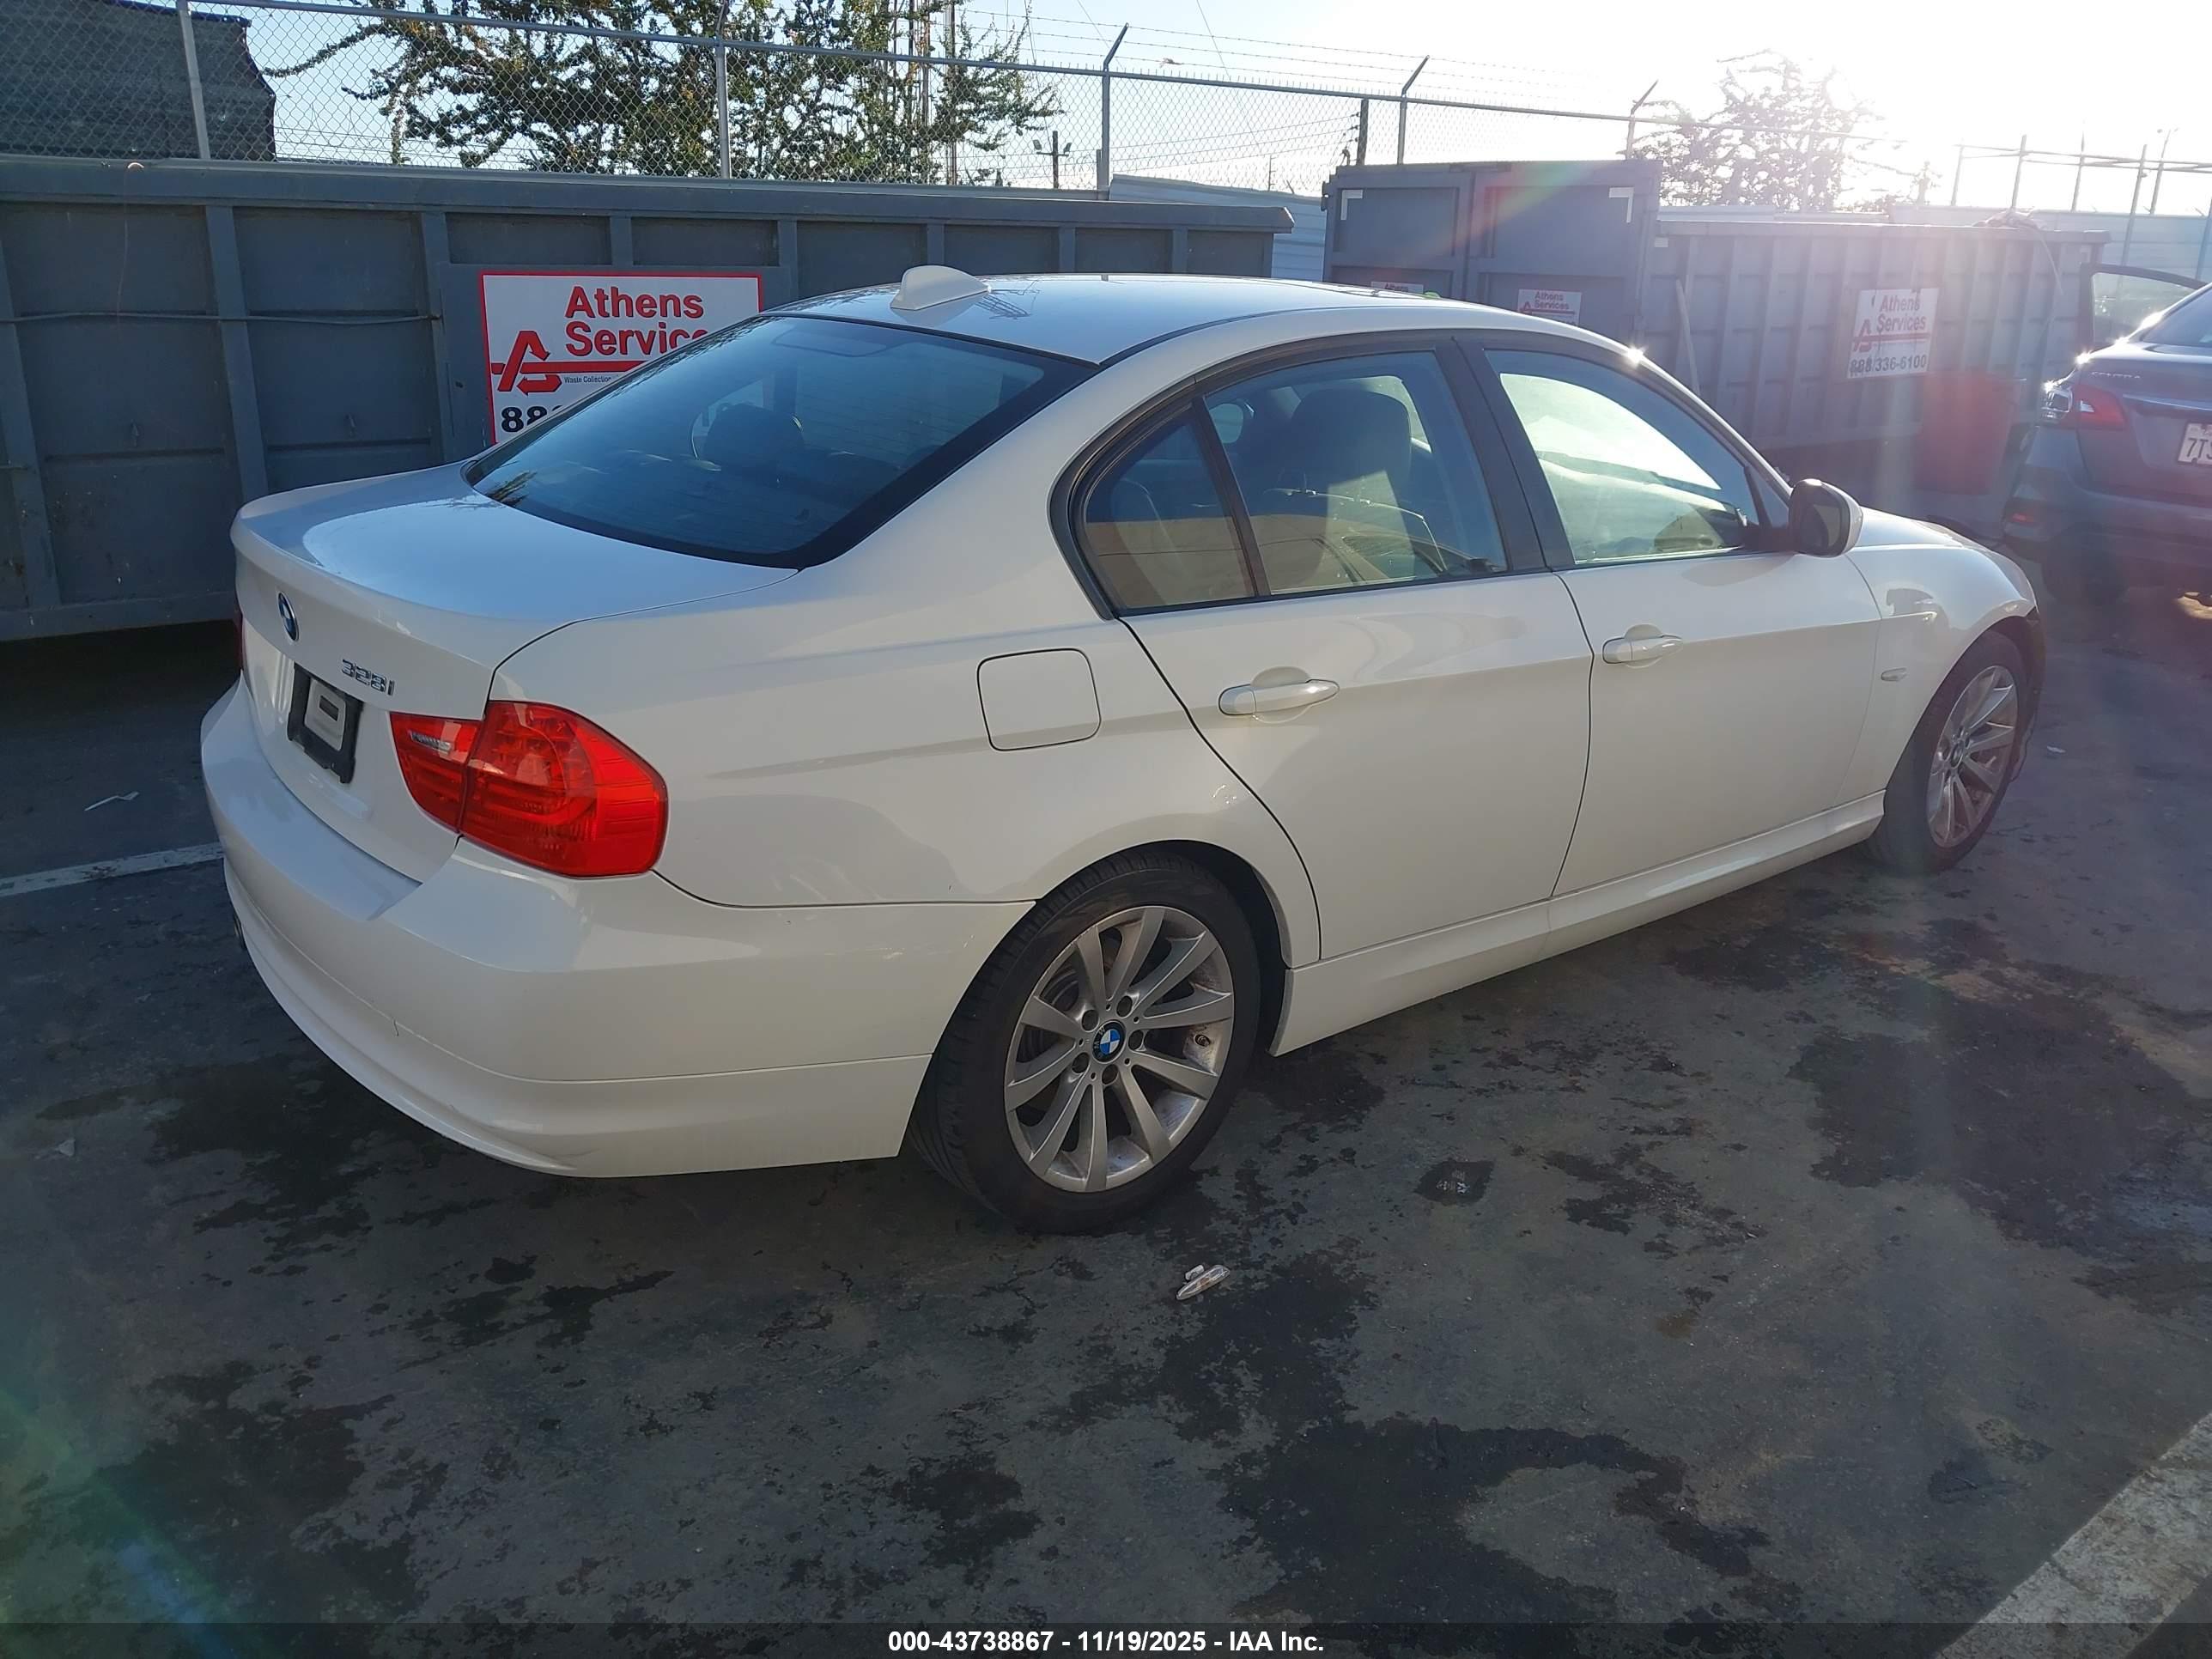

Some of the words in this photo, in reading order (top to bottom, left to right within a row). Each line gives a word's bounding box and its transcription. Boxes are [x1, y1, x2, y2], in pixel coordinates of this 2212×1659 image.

[565, 285, 704, 318] Athens
[1534, 291, 1564, 301] Athens
[1880, 295, 1921, 312] Athens
[1877, 313, 1928, 332] Services
[565, 320, 708, 356] Servic
[501, 404, 562, 433] 88
[342, 659, 396, 696] 328i
